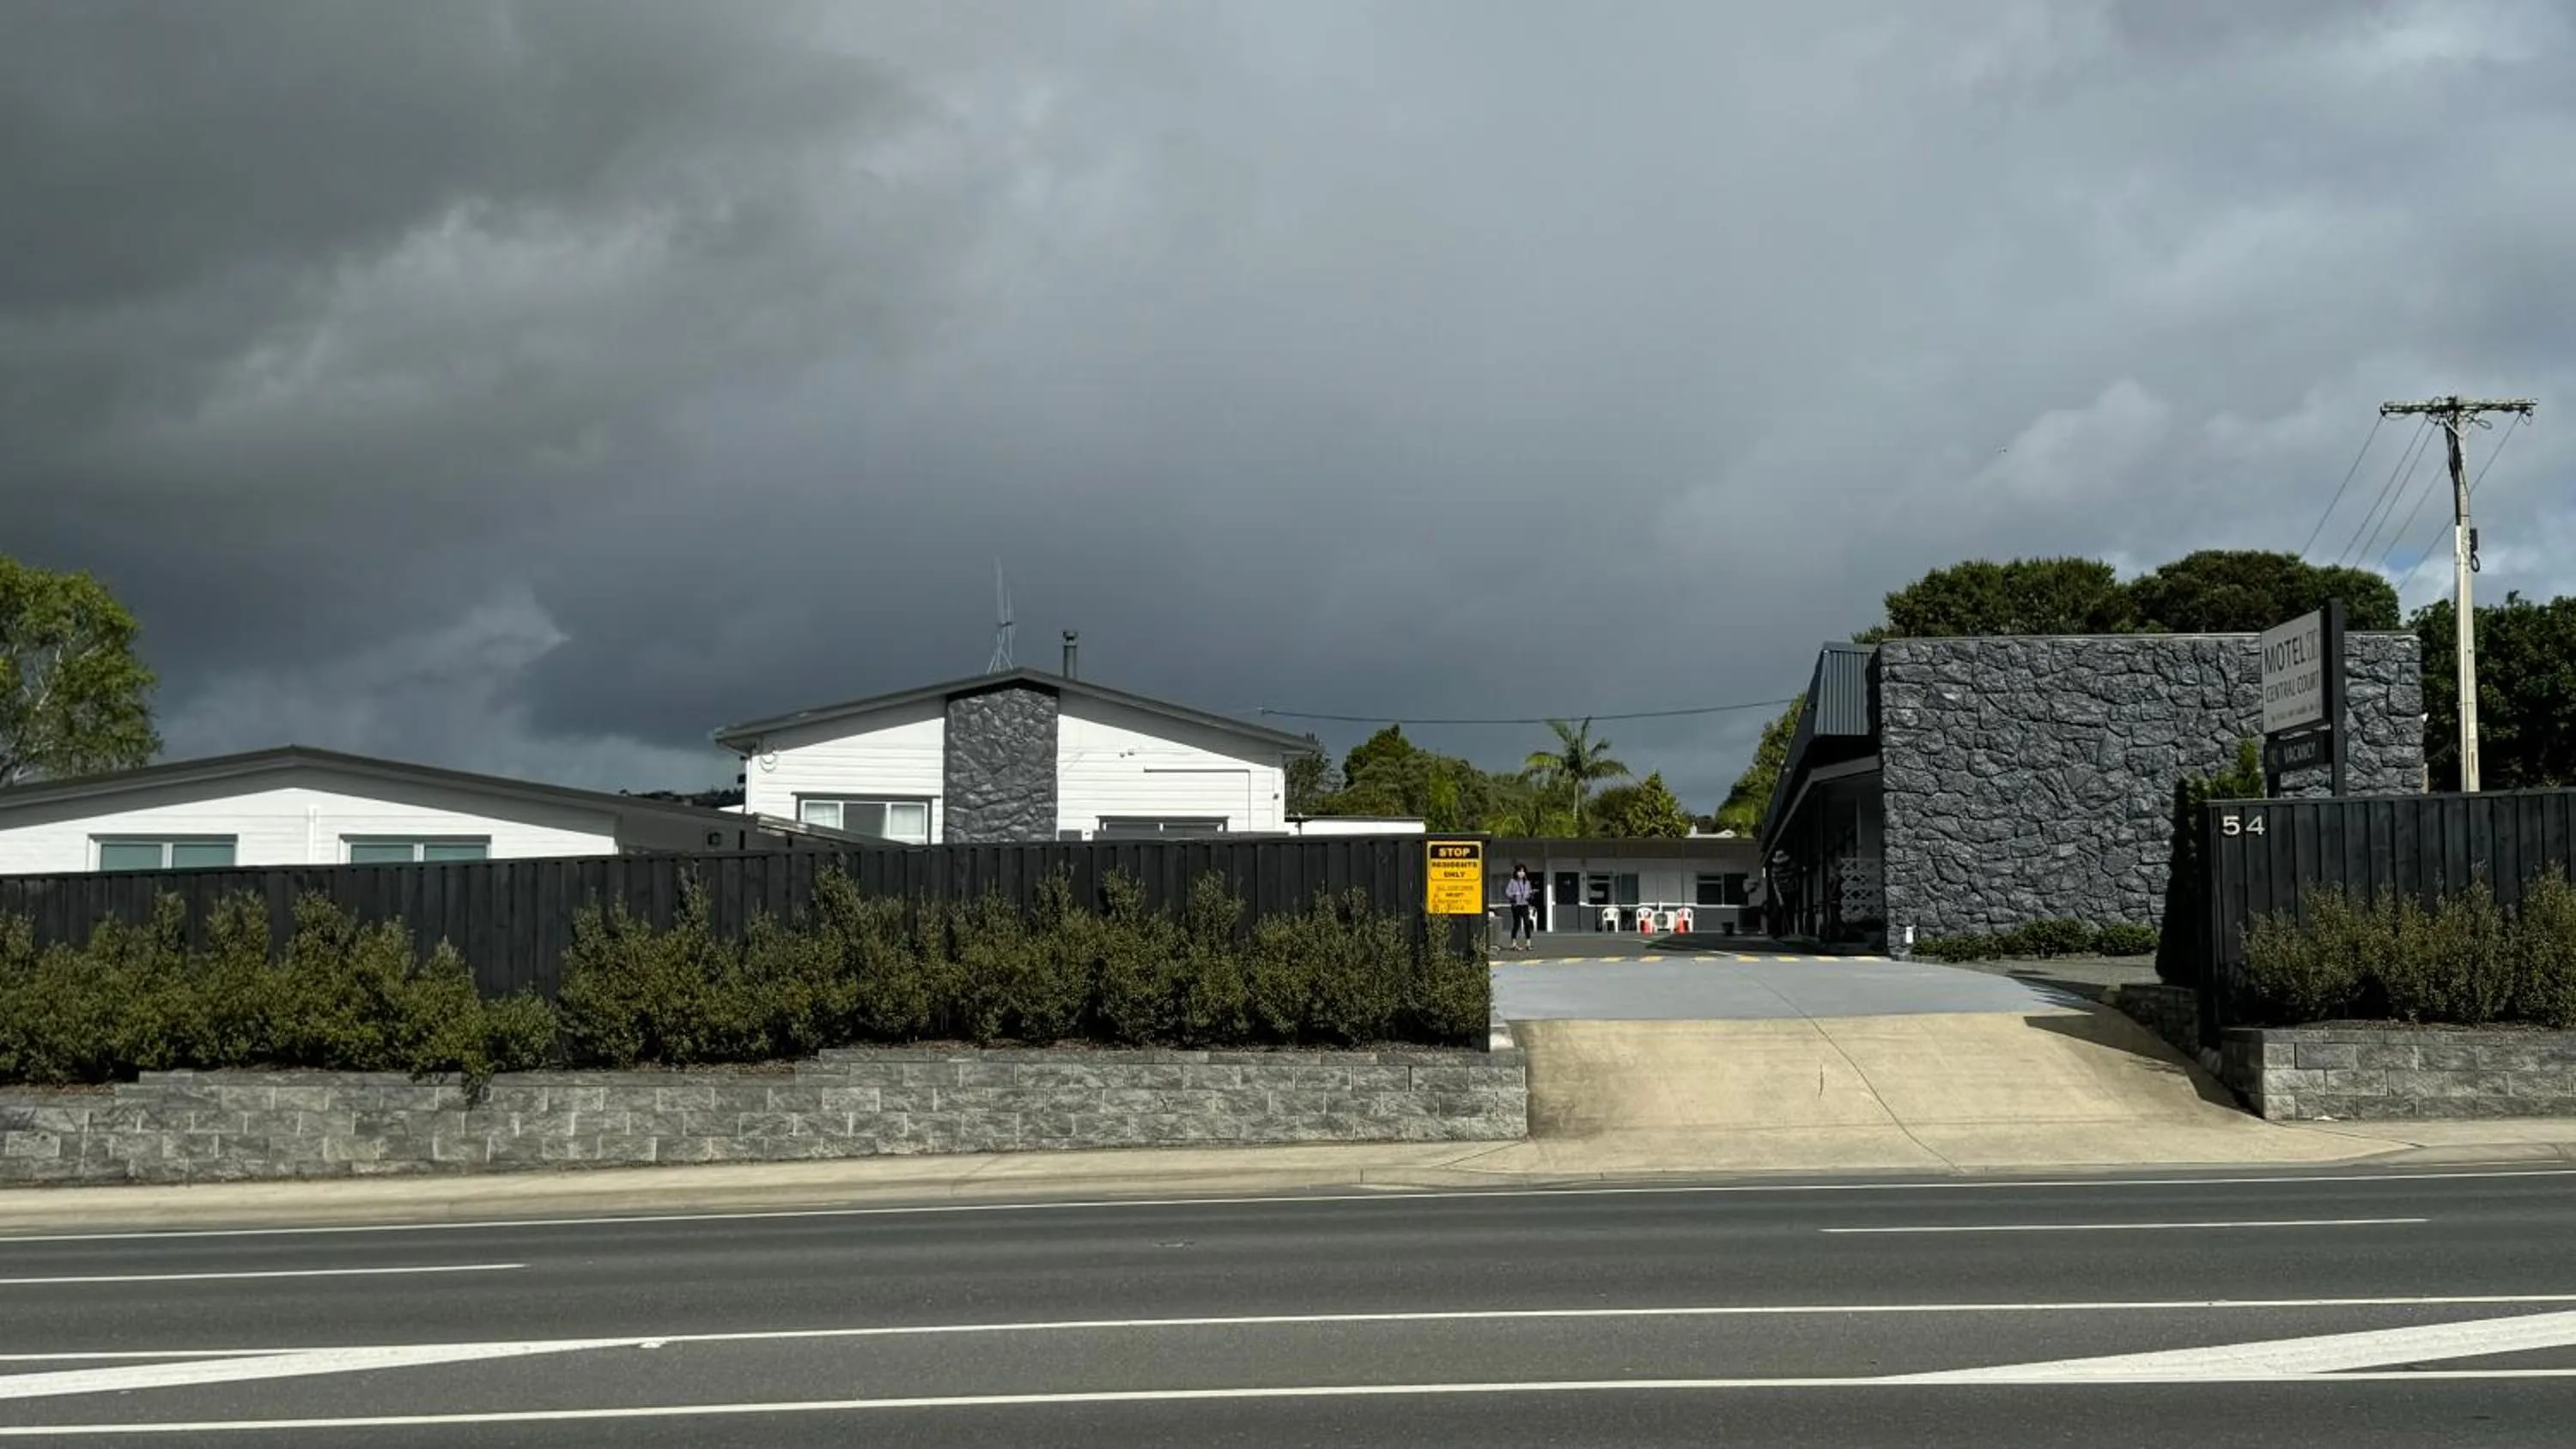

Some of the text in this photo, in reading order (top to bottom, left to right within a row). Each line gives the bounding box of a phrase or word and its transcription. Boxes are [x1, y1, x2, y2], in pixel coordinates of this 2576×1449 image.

[2264, 634, 2306, 675] MOTEL
[2266, 677, 2295, 702] CENTRAL
[2283, 741, 2316, 763] VACANCY
[2222, 815, 2265, 835] 54
[1438, 847, 1471, 858] STOP
